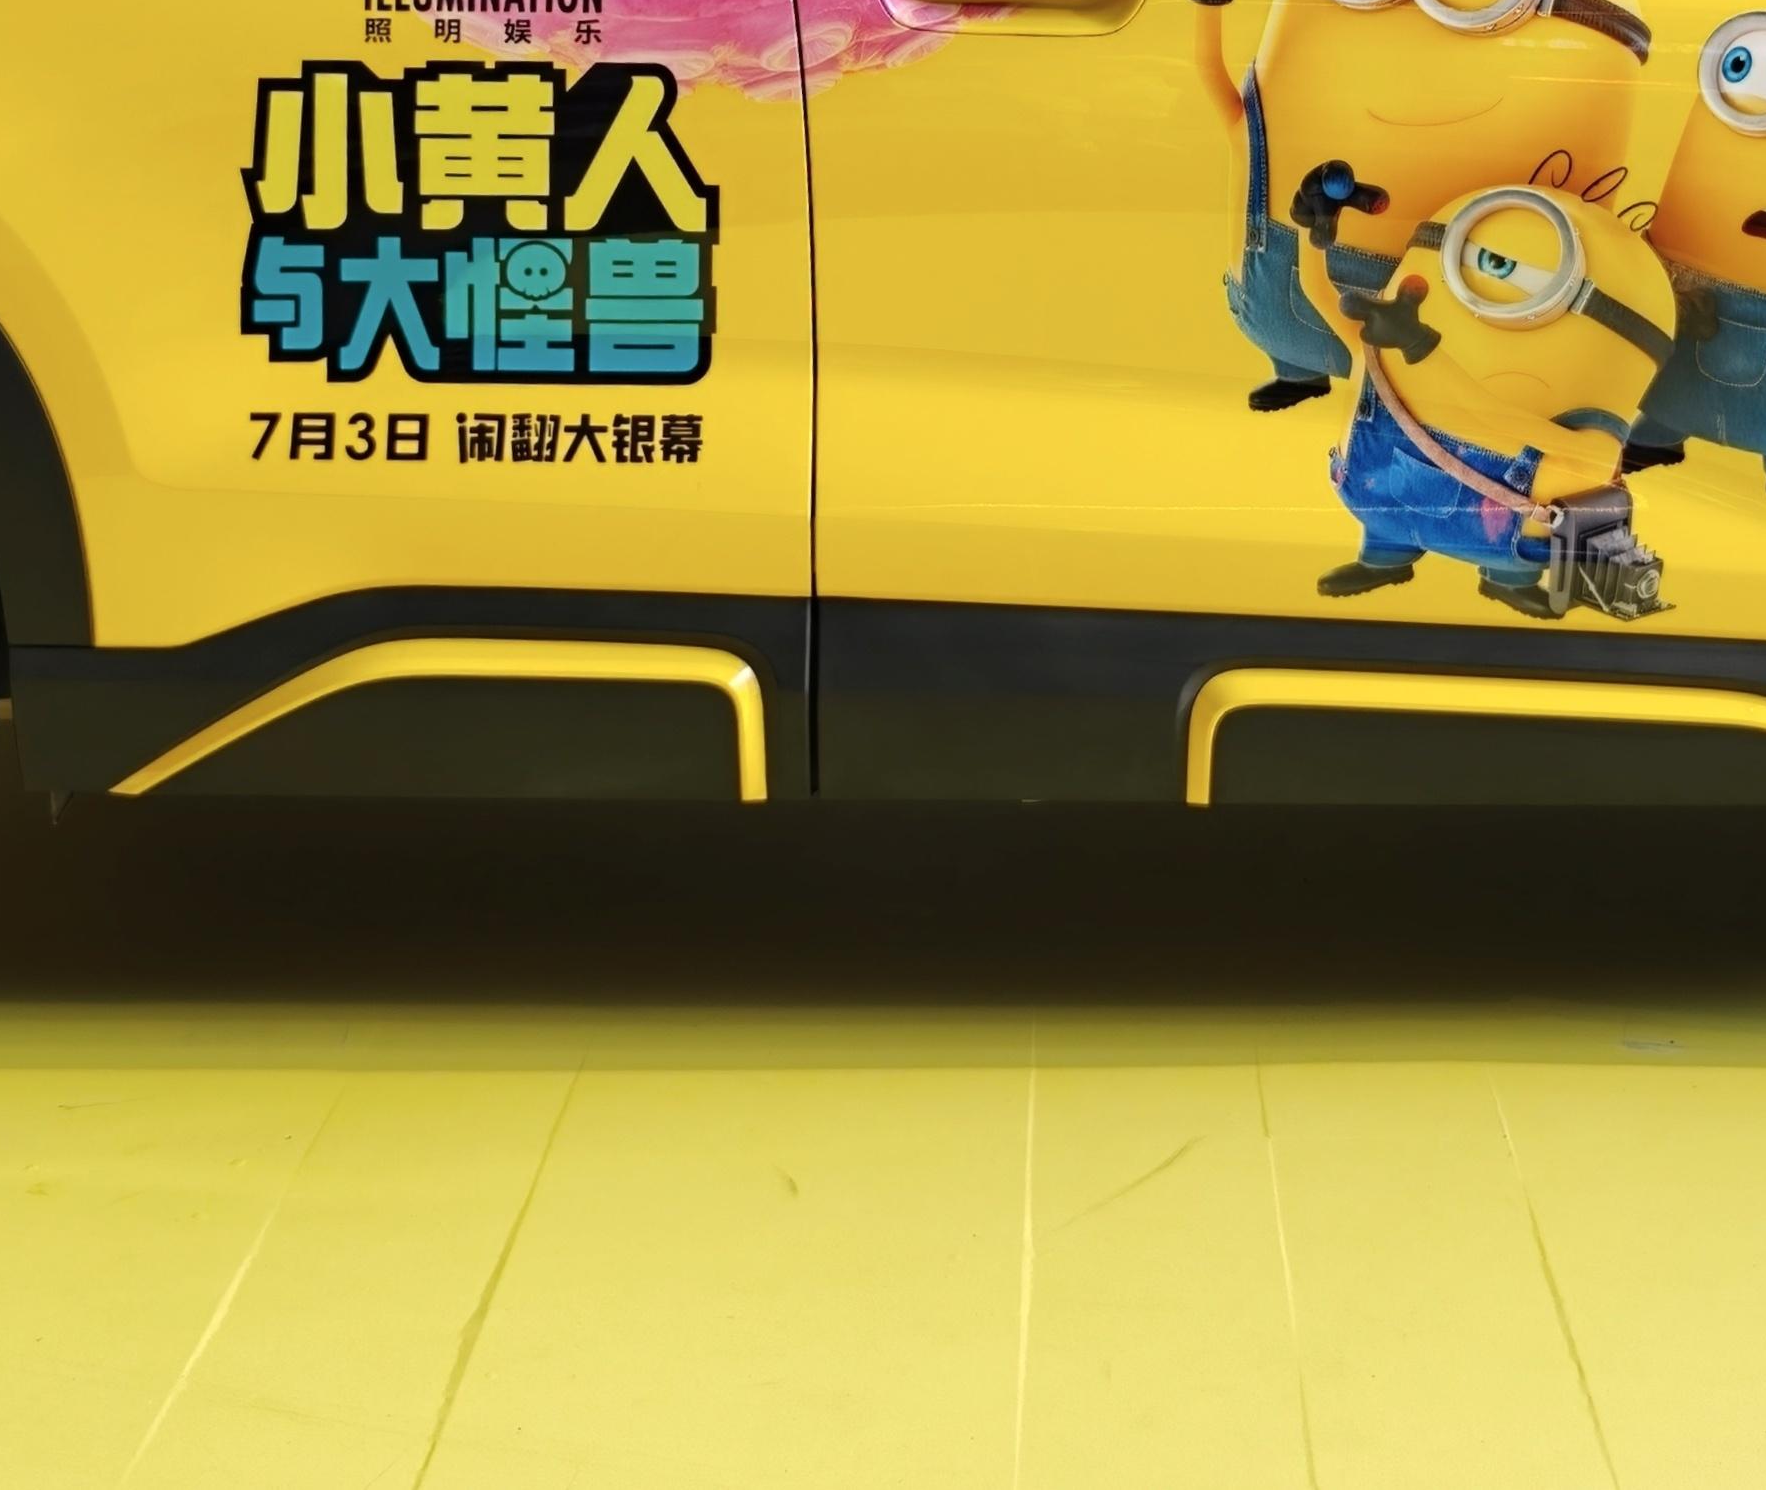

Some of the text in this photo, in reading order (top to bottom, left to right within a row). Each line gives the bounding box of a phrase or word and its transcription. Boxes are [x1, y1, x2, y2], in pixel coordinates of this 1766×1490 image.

[364, 17, 603, 45] 照明娱乐
[246, 63, 715, 233] 小黄人
[246, 235, 711, 376] 与大怪兽
[249, 411, 704, 464] 7月3日 闹翻大银幕
